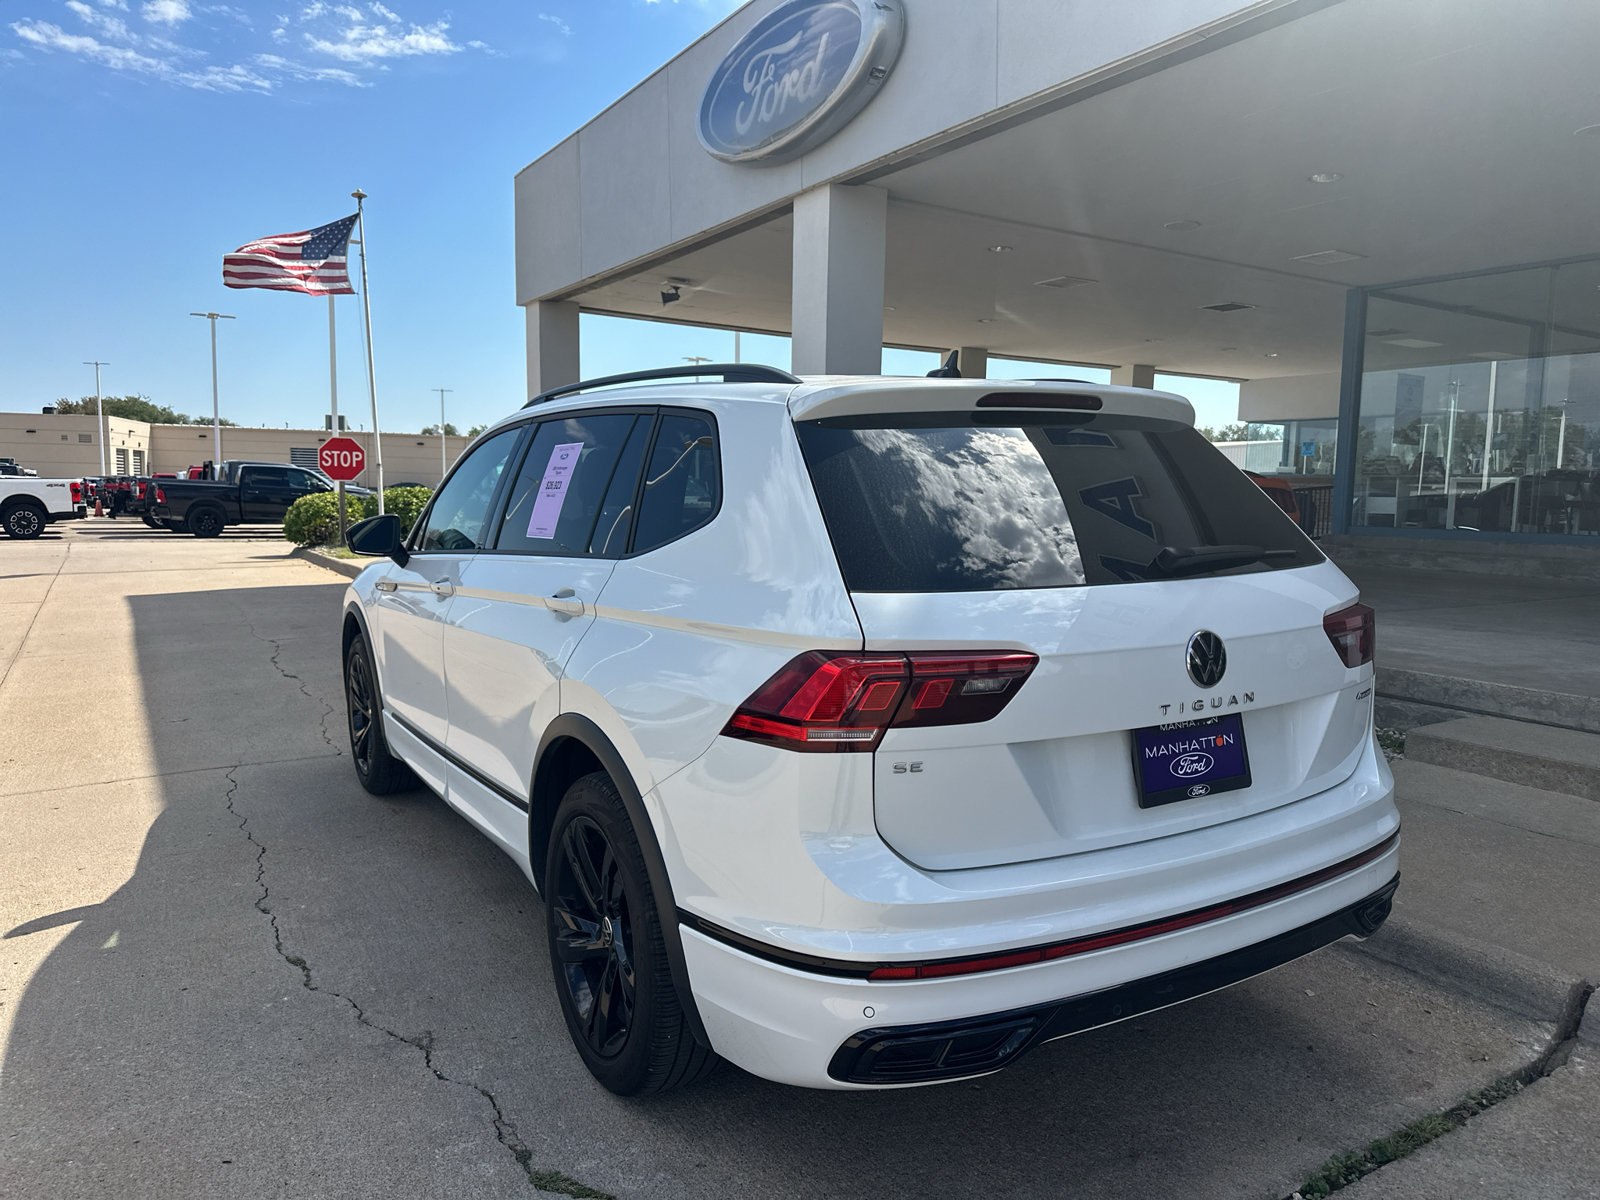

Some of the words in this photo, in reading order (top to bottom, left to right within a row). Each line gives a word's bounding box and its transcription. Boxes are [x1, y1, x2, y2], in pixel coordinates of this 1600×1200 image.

[735, 30, 829, 135] Ford
[321, 450, 363, 468] STOP
[1159, 691, 1255, 716] TIGUAN
[892, 760, 923, 774] SE
[1177, 755, 1207, 775] Ford
[1191, 786, 1207, 796] Ford
